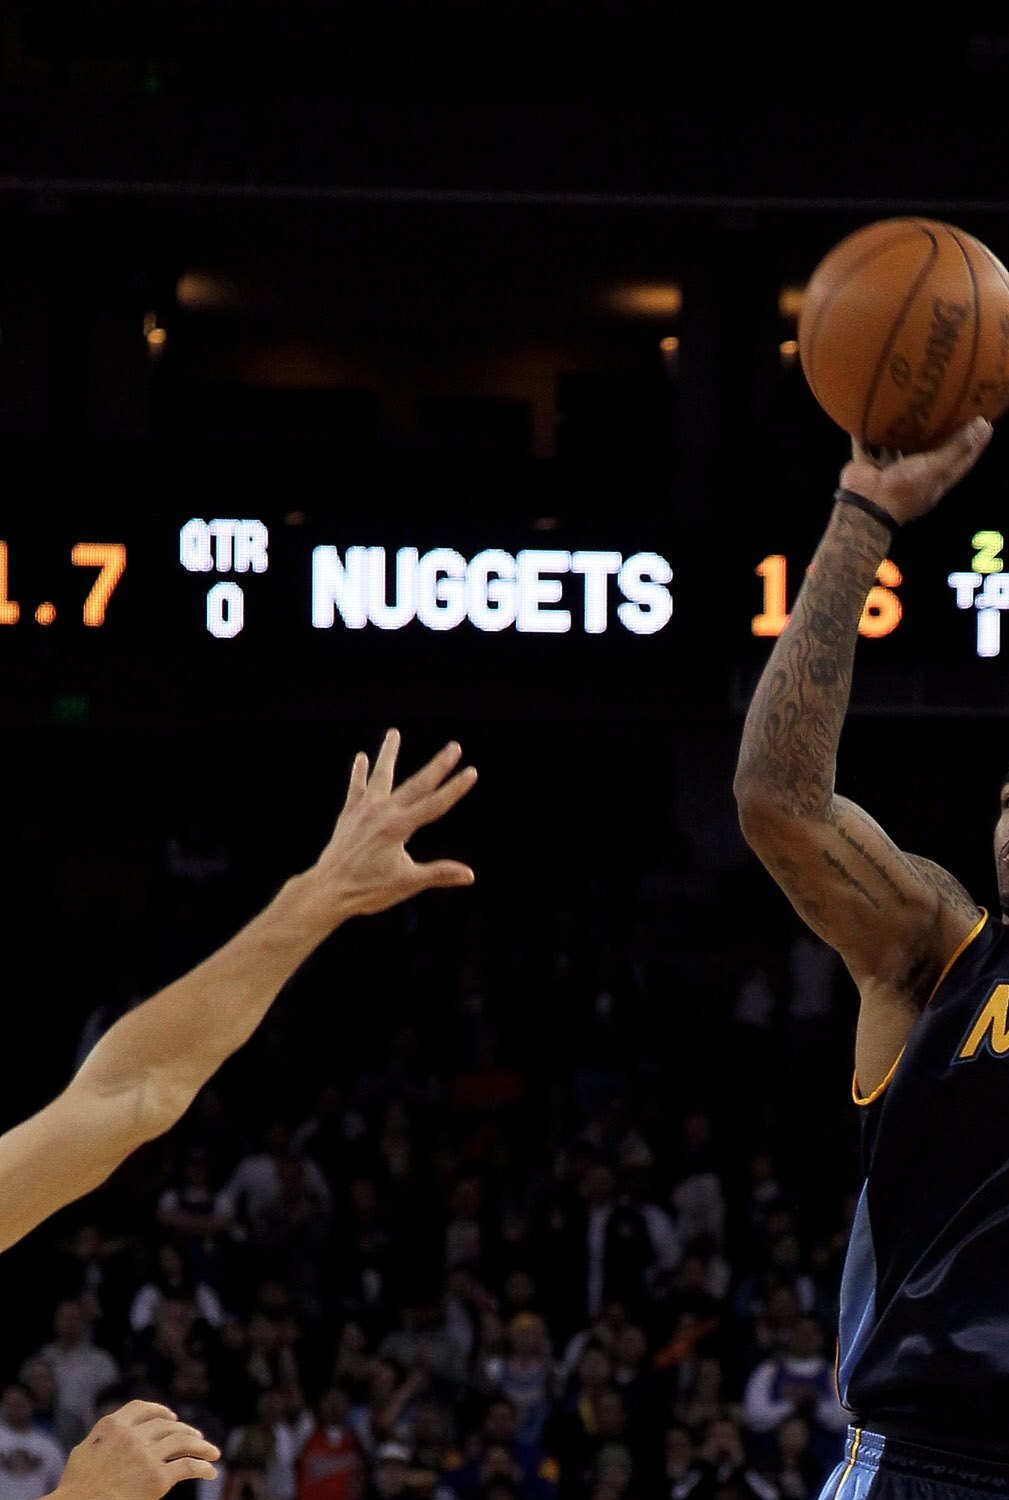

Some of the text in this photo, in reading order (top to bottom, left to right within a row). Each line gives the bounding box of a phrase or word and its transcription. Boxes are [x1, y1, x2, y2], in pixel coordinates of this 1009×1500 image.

[179, 517, 269, 573] QTR
[971, 531, 1004, 573] 2
[206, 581, 244, 639] 0
[311, 544, 674, 635] NUGGETS
[751, 554, 903, 638] 16
